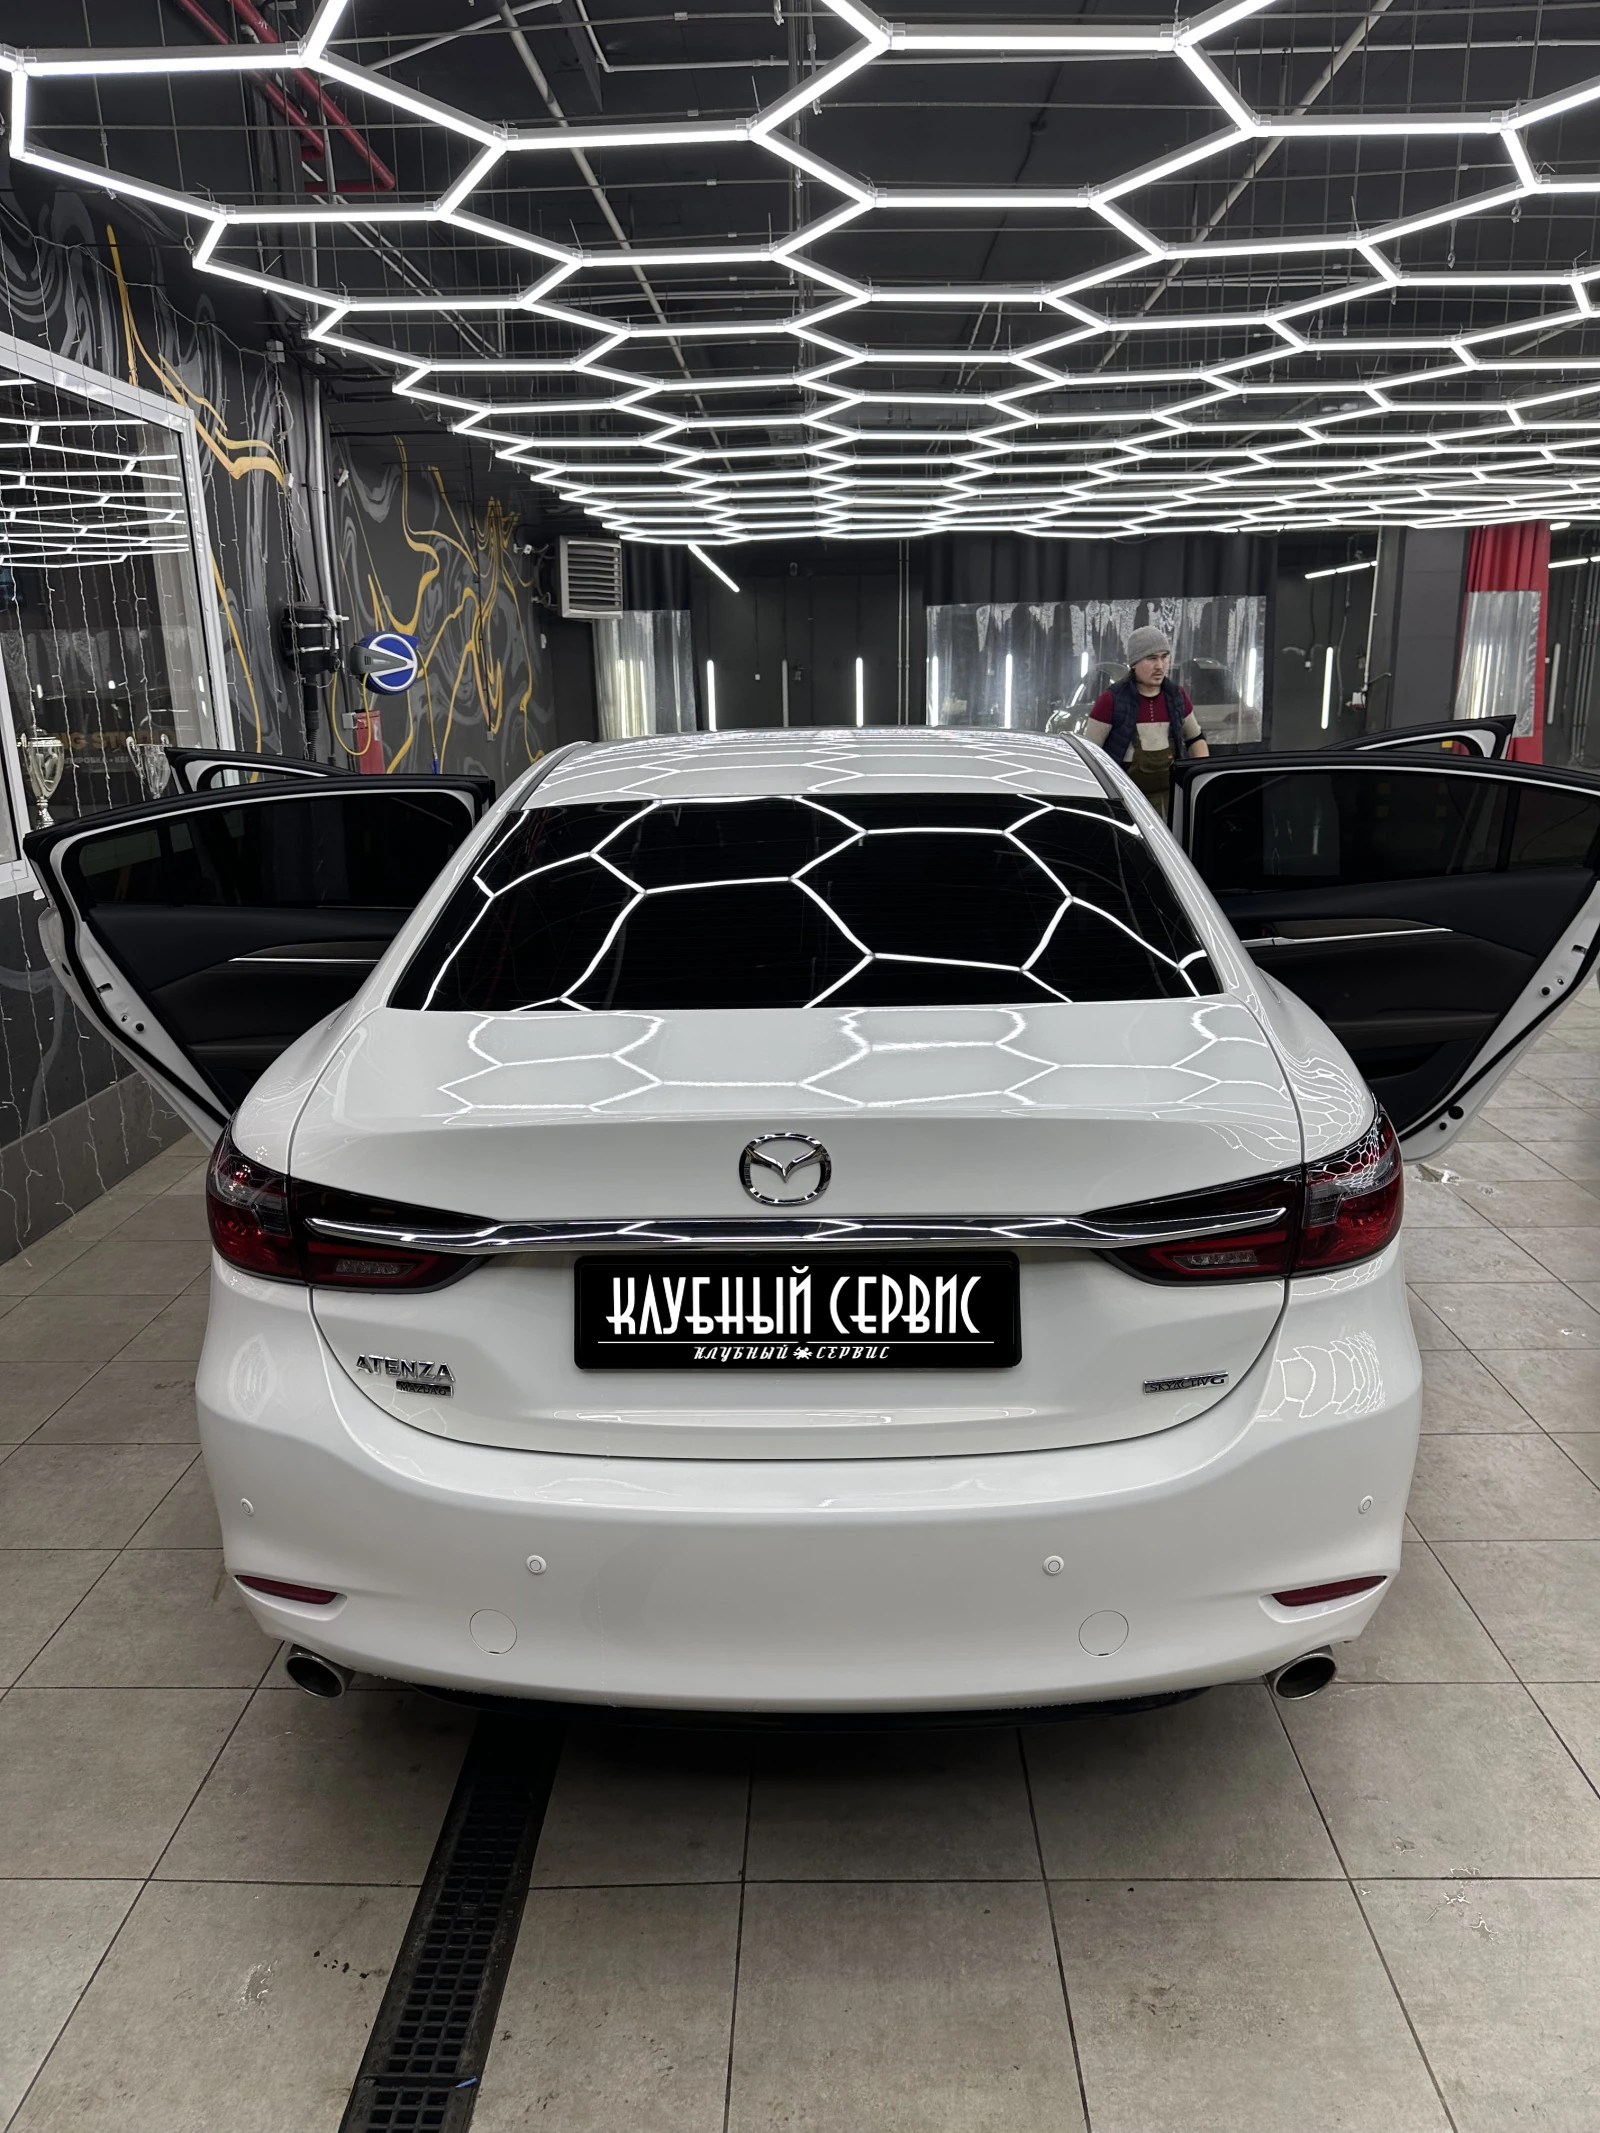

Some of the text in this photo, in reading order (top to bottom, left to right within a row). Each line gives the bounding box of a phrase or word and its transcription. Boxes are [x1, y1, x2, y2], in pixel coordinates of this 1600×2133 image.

[606, 1266, 982, 1335] КЛУБНЫЙ СЕРВИС
[693, 1345, 890, 1362] КЛУБНЫЙ СЕРВИС
[356, 1354, 456, 1382] ATENZA
